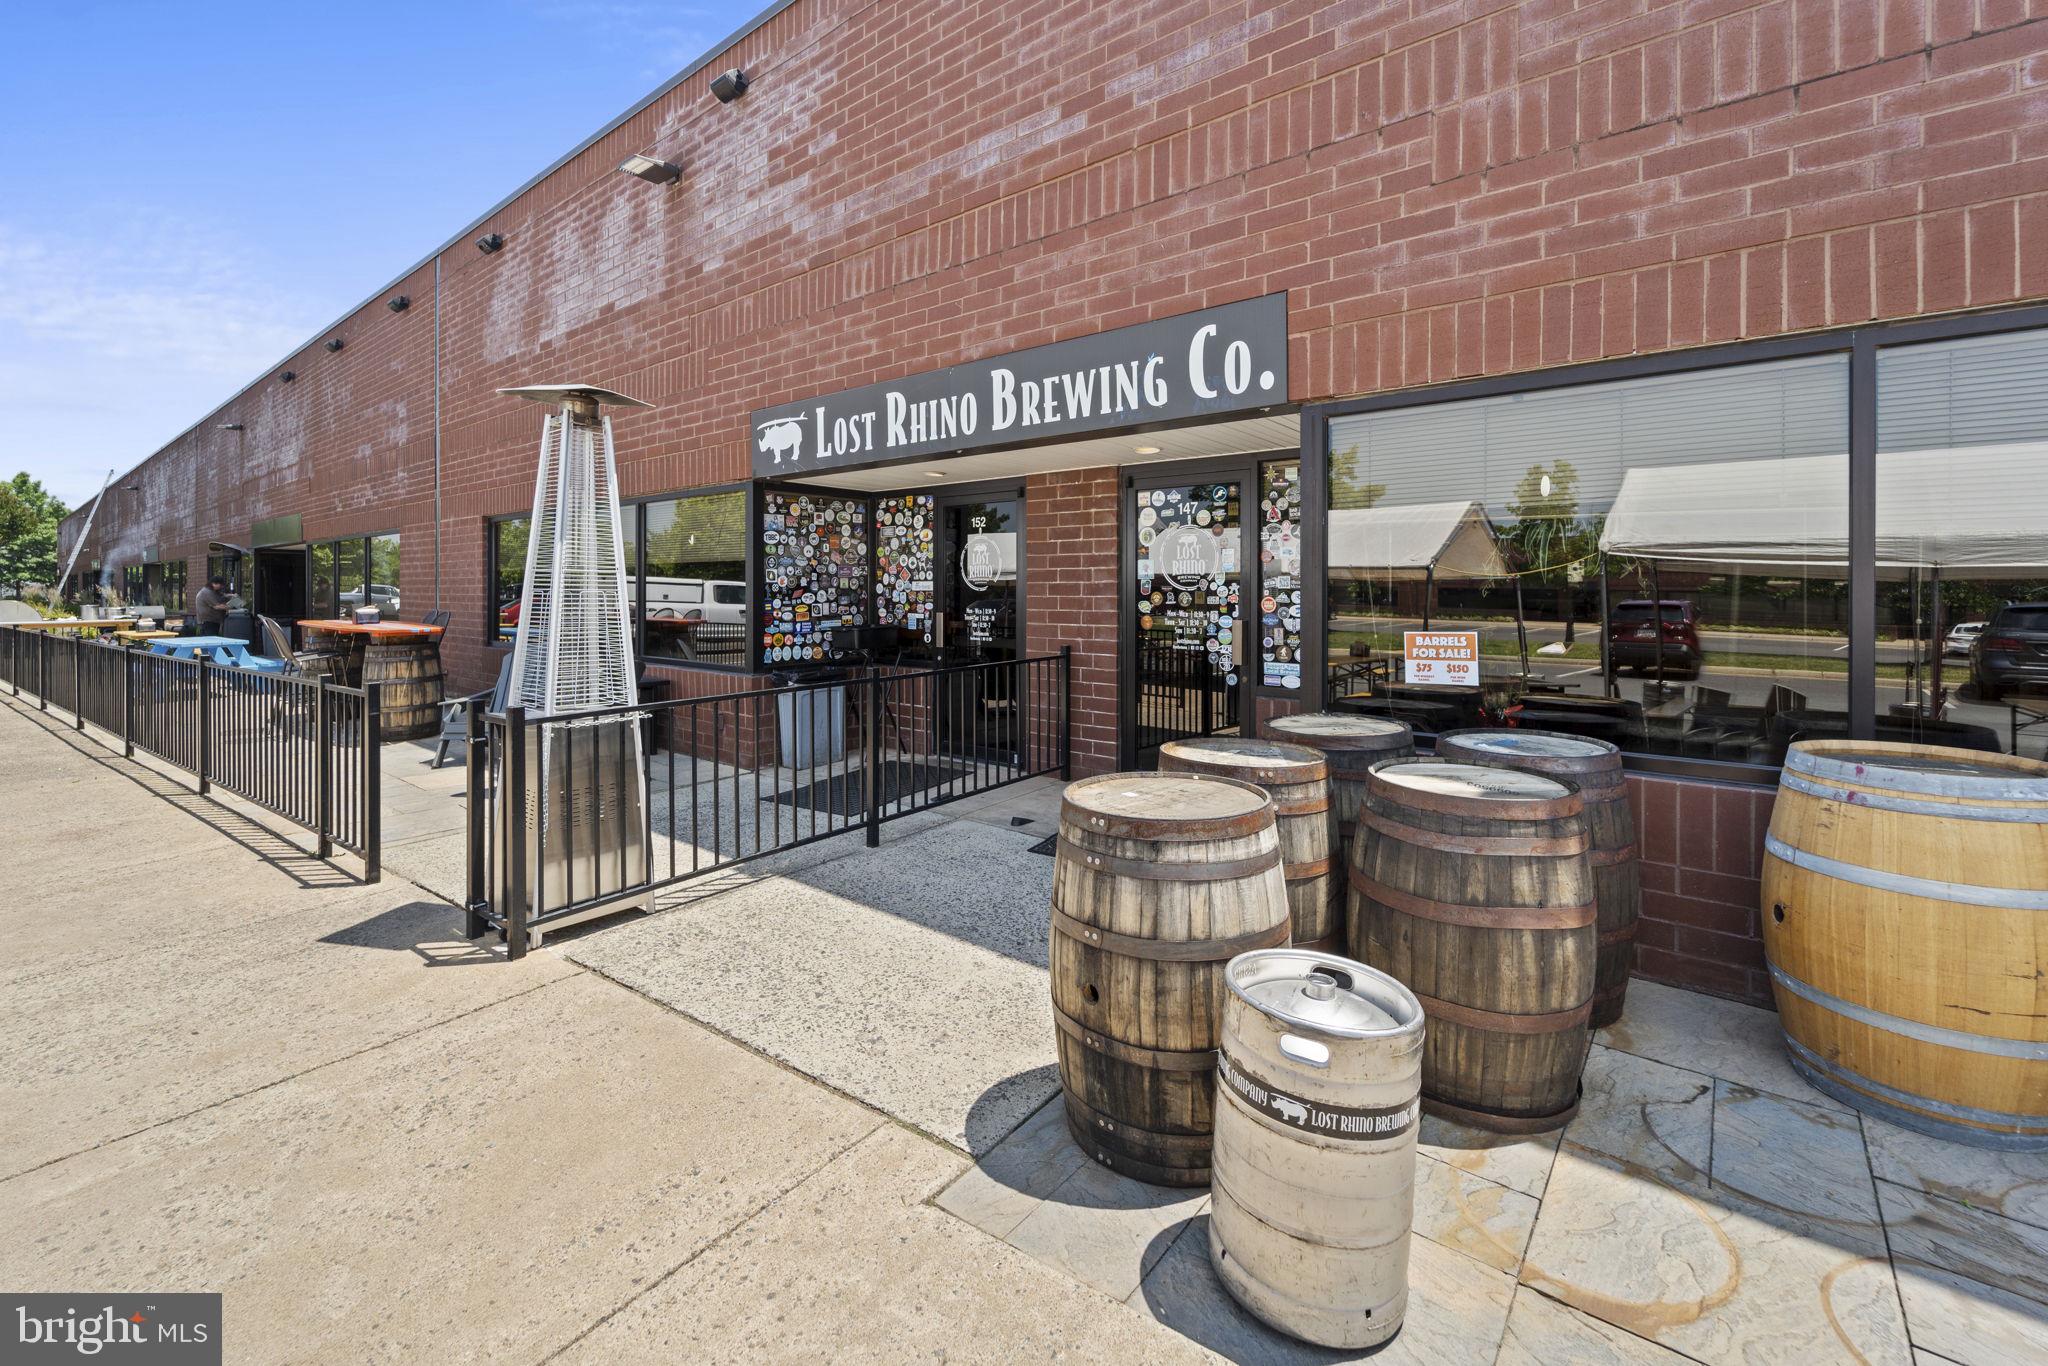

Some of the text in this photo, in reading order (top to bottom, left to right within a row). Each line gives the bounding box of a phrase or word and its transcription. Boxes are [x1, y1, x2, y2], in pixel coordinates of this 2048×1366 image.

[816, 406, 876, 458] LOST
[886, 391, 978, 448] RHINO
[991, 356, 1168, 432] BREWING
[1178, 502, 1198, 515] 147
[971, 516, 986, 528] 152
[1177, 544, 1201, 560] LOST
[1172, 559, 1206, 576] RHINO
[1415, 636, 1467, 647] BARRELS
[1412, 648, 1471, 659] FOR SALE!
[1416, 663, 1469, 674] $75 $150
[1231, 1069, 1268, 1106] COMPANY
[1311, 1109, 1338, 1130] LOST
[1340, 1115, 1373, 1133] RHINO
[1375, 1108, 1410, 1133] BREWING
